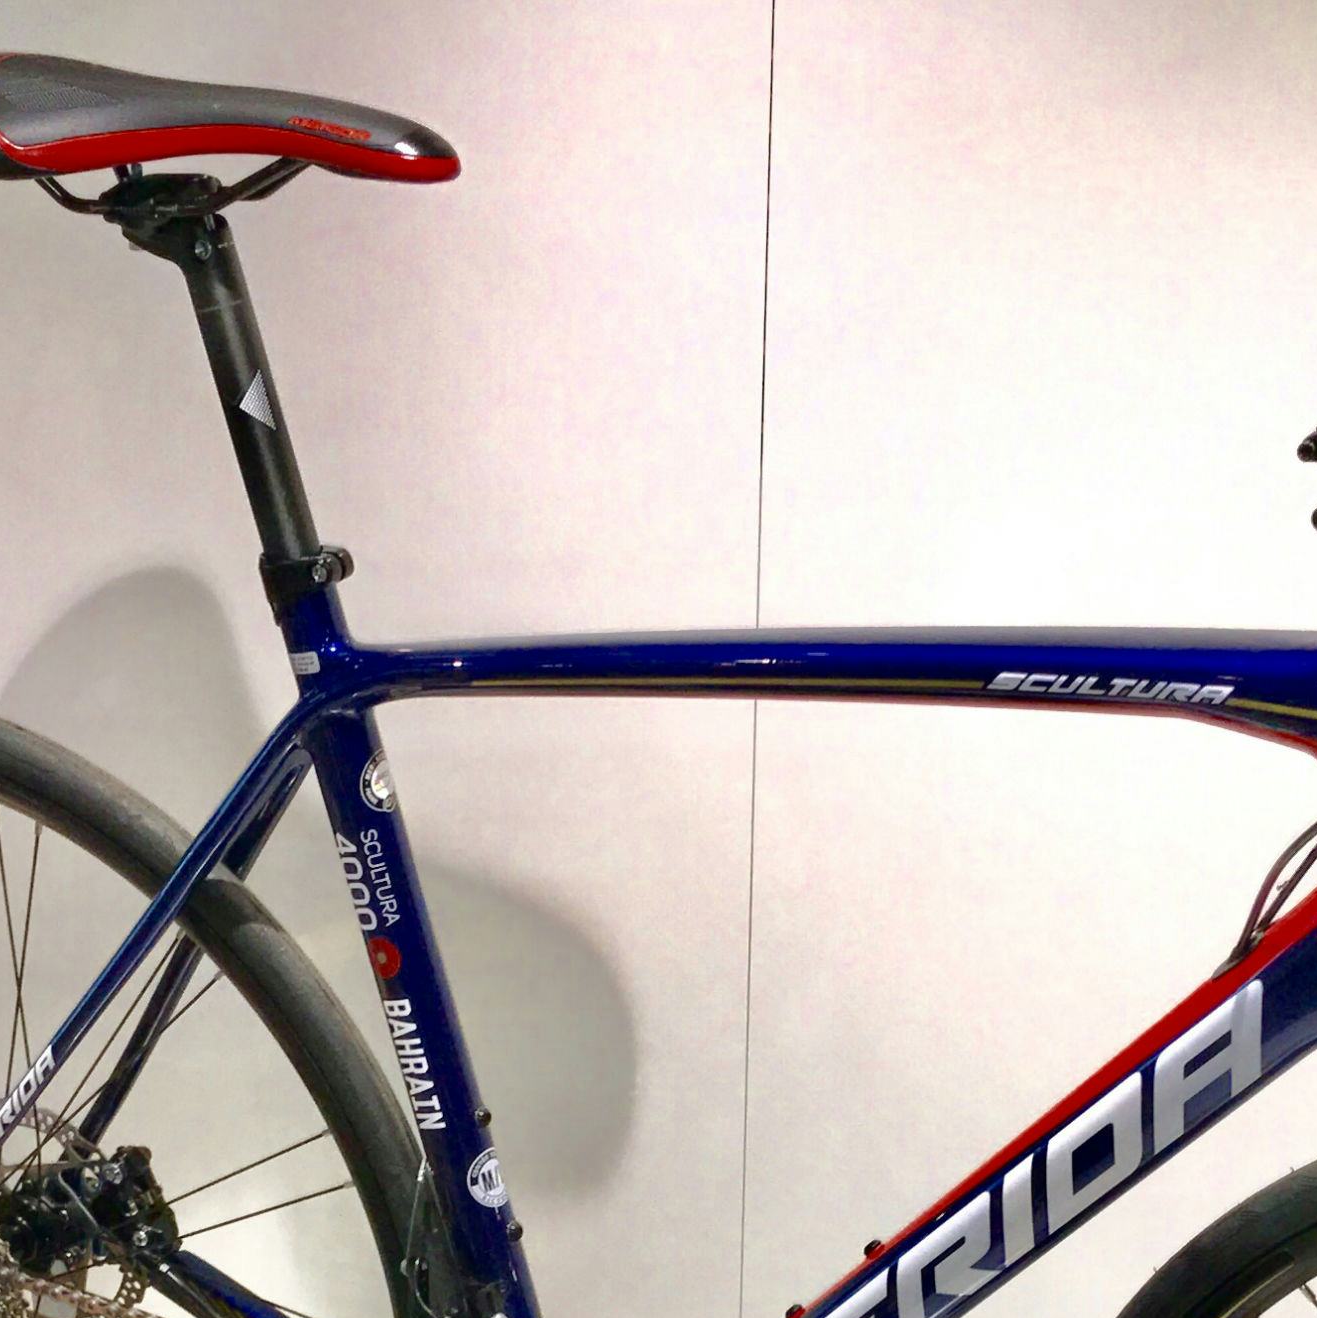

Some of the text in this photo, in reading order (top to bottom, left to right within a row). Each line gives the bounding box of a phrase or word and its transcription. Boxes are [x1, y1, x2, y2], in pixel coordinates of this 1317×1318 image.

[987, 671, 1235, 704] SCULTURA
[335, 832, 378, 931] 4000
[360, 829, 400, 927] SCULTURA
[383, 998, 447, 1131] BAHRAIN
